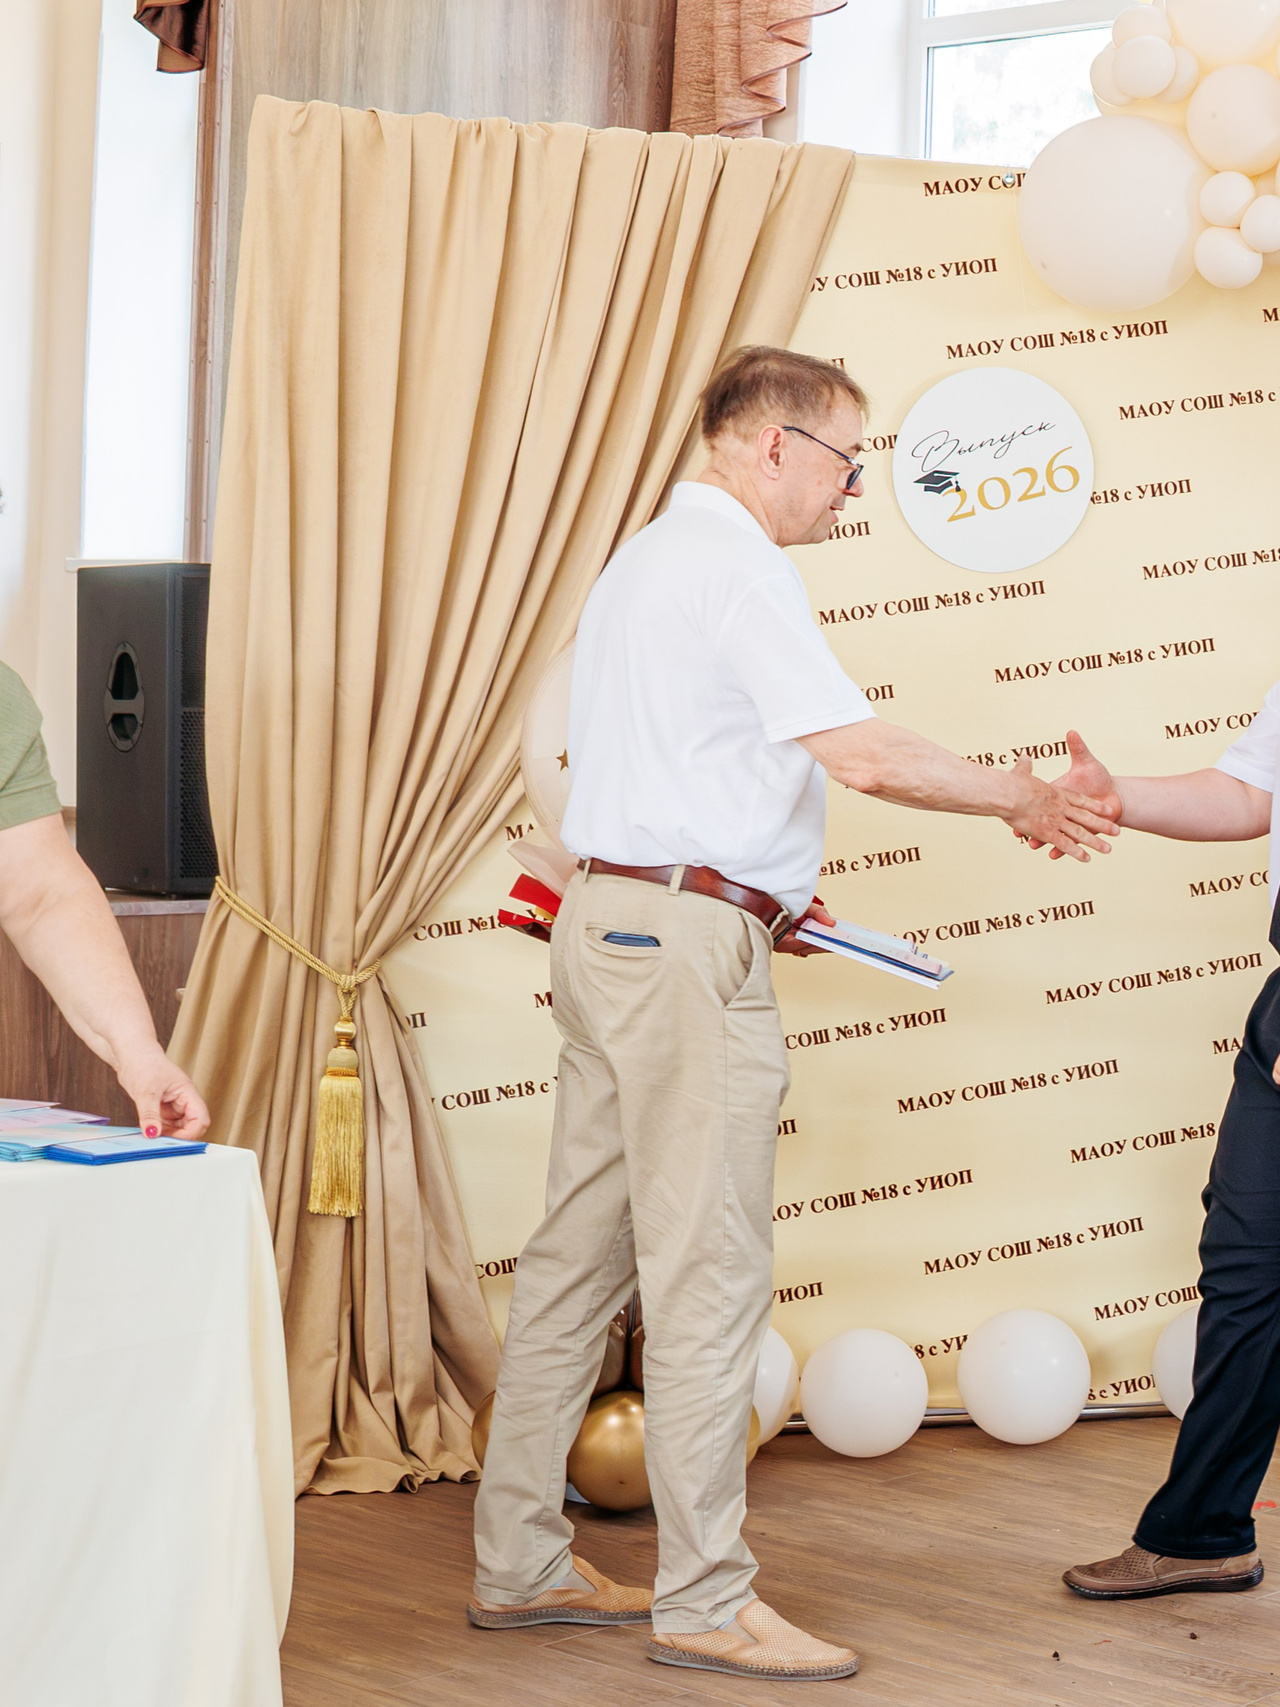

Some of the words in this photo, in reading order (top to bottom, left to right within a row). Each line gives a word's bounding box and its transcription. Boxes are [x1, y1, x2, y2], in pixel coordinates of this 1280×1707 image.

[923, 176, 983, 197] МАОУ
[834, 270, 881, 290] СОШ
[885, 266, 923, 284] №18
[927, 268, 936, 280] с
[940, 257, 998, 278] УИОП
[946, 338, 1004, 360] МАОУ
[1010, 333, 1055, 352] СОШ
[1060, 328, 1096, 346] №18
[1100, 331, 1108, 342] с
[1112, 319, 1169, 340] УИОП
[1119, 399, 1175, 420] МАОУ
[1180, 394, 1225, 413] СОШ
[1229, 389, 1264, 407] №18
[1267, 391, 1276, 402] с
[911, 422, 1056, 473] Выпуск
[941, 445, 1080, 523] 2026
[1124, 491, 1132, 501] с
[1135, 479, 1192, 500] УИОП
[828, 520, 871, 541] ИОП
[1142, 558, 1198, 580] МАОУ
[1204, 552, 1248, 571] СОШ
[818, 603, 878, 626] МАОУ
[883, 596, 930, 616] СОШ
[934, 590, 972, 610] №18
[975, 592, 984, 604] с
[988, 580, 1045, 602] УИОП
[994, 661, 1052, 683] МАОУ
[1057, 654, 1103, 674] СОШ
[1107, 648, 1144, 667] №18
[1147, 650, 1156, 661] с
[1159, 637, 1215, 659] УИОП
[861, 684, 895, 702] ОП
[1164, 717, 1221, 740] МАОУ
[1226, 711, 1258, 730] СО
[998, 754, 1007, 765] с
[850, 860, 860, 872] с
[862, 846, 922, 870] УИОП
[1188, 874, 1244, 898] МАОУ
[895, 928, 930, 945] ОУ
[935, 919, 981, 941] СОШ
[985, 913, 1022, 933] №18
[1025, 914, 1035, 926] с
[1037, 900, 1095, 924] УИОП
[1045, 980, 1103, 1005] МАОУ
[1108, 972, 1153, 994] СОШ
[1156, 965, 1192, 985] №18
[1195, 965, 1205, 978] с
[1207, 952, 1263, 976] УИОП
[784, 1028, 832, 1050] СОШ
[834, 1021, 873, 1042] №18
[876, 1022, 885, 1034] с
[887, 1007, 947, 1032] УИОП
[1211, 1037, 1241, 1055] МА
[441, 1088, 492, 1111] СОШ
[495, 1080, 536, 1102] №18
[539, 1082, 550, 1094] с
[896, 1089, 956, 1114] МАОУ
[961, 1080, 1007, 1102] СОШ
[1010, 1072, 1048, 1093] №18
[1050, 1073, 1060, 1086] с
[1062, 1059, 1120, 1083] УИОП
[1070, 1139, 1127, 1164] МАОУ
[1132, 1129, 1177, 1151] СОШ
[1180, 1122, 1216, 1143] №18
[810, 1191, 858, 1214] СОШ
[860, 1183, 899, 1205] №18
[902, 1184, 912, 1196] с
[914, 1168, 973, 1194] УИОП
[923, 1250, 982, 1276] МАОУ
[987, 1239, 1033, 1262] СОШ
[1036, 1232, 1073, 1253] №18
[1076, 1233, 1085, 1244] с
[1087, 1216, 1145, 1242] УИОП
[1094, 1295, 1150, 1321] МАОУ
[1154, 1285, 1199, 1307] СОШ
[940, 1334, 969, 1354] УИ
